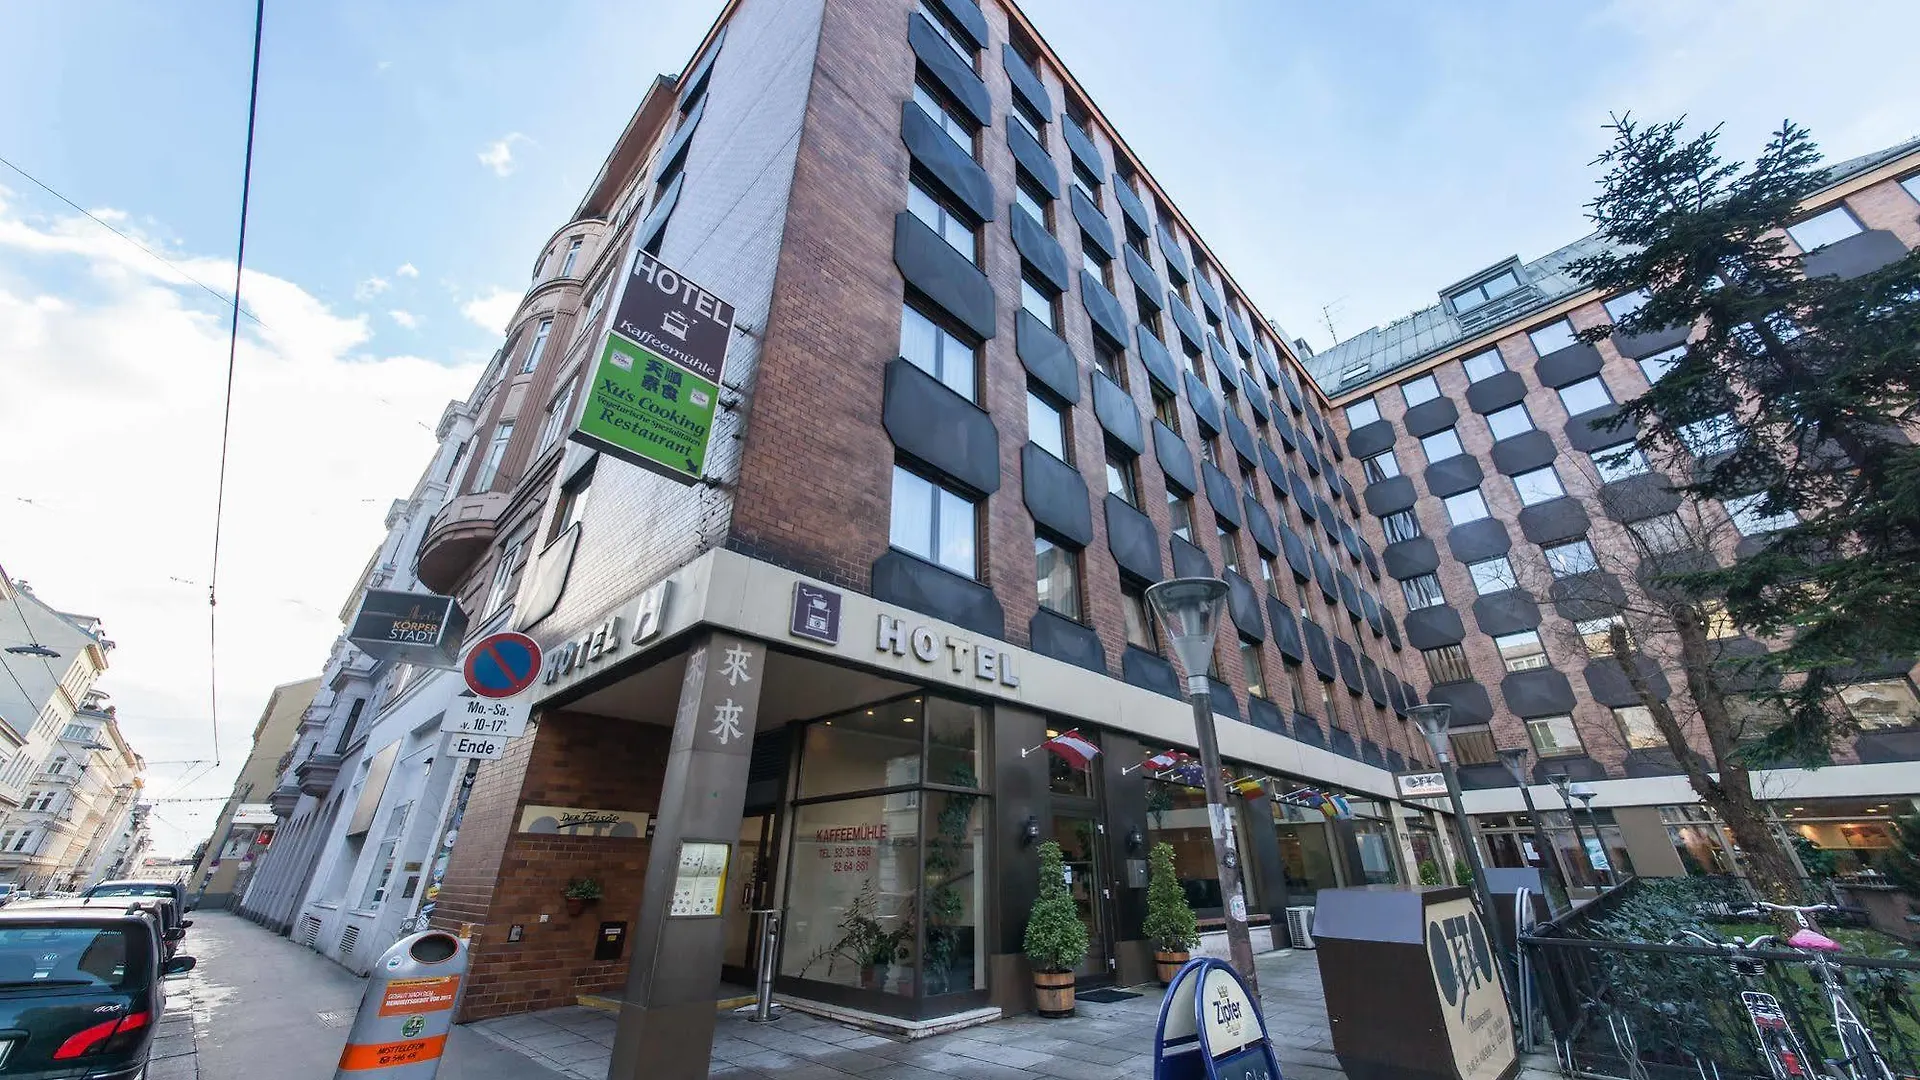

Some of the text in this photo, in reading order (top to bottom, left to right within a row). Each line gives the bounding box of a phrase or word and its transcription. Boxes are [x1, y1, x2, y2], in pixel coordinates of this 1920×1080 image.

[633, 253, 728, 328] HOTEL
[620, 319, 716, 376] Kaffeemühle
[600, 378, 705, 437] Xu's Cooking
[599, 408, 693, 456] Restaurant
[389, 629, 437, 642] STADT
[393, 620, 438, 632] KÖRPER
[541, 616, 620, 686] HOTEL
[876, 613, 1020, 688] HOTEL
[467, 701, 509, 716] Mo.-Sa.
[458, 738, 495, 754] Ende
[816, 823, 887, 842] KAFFEEMÜHLE
[1213, 998, 1243, 1028] Zipfer
